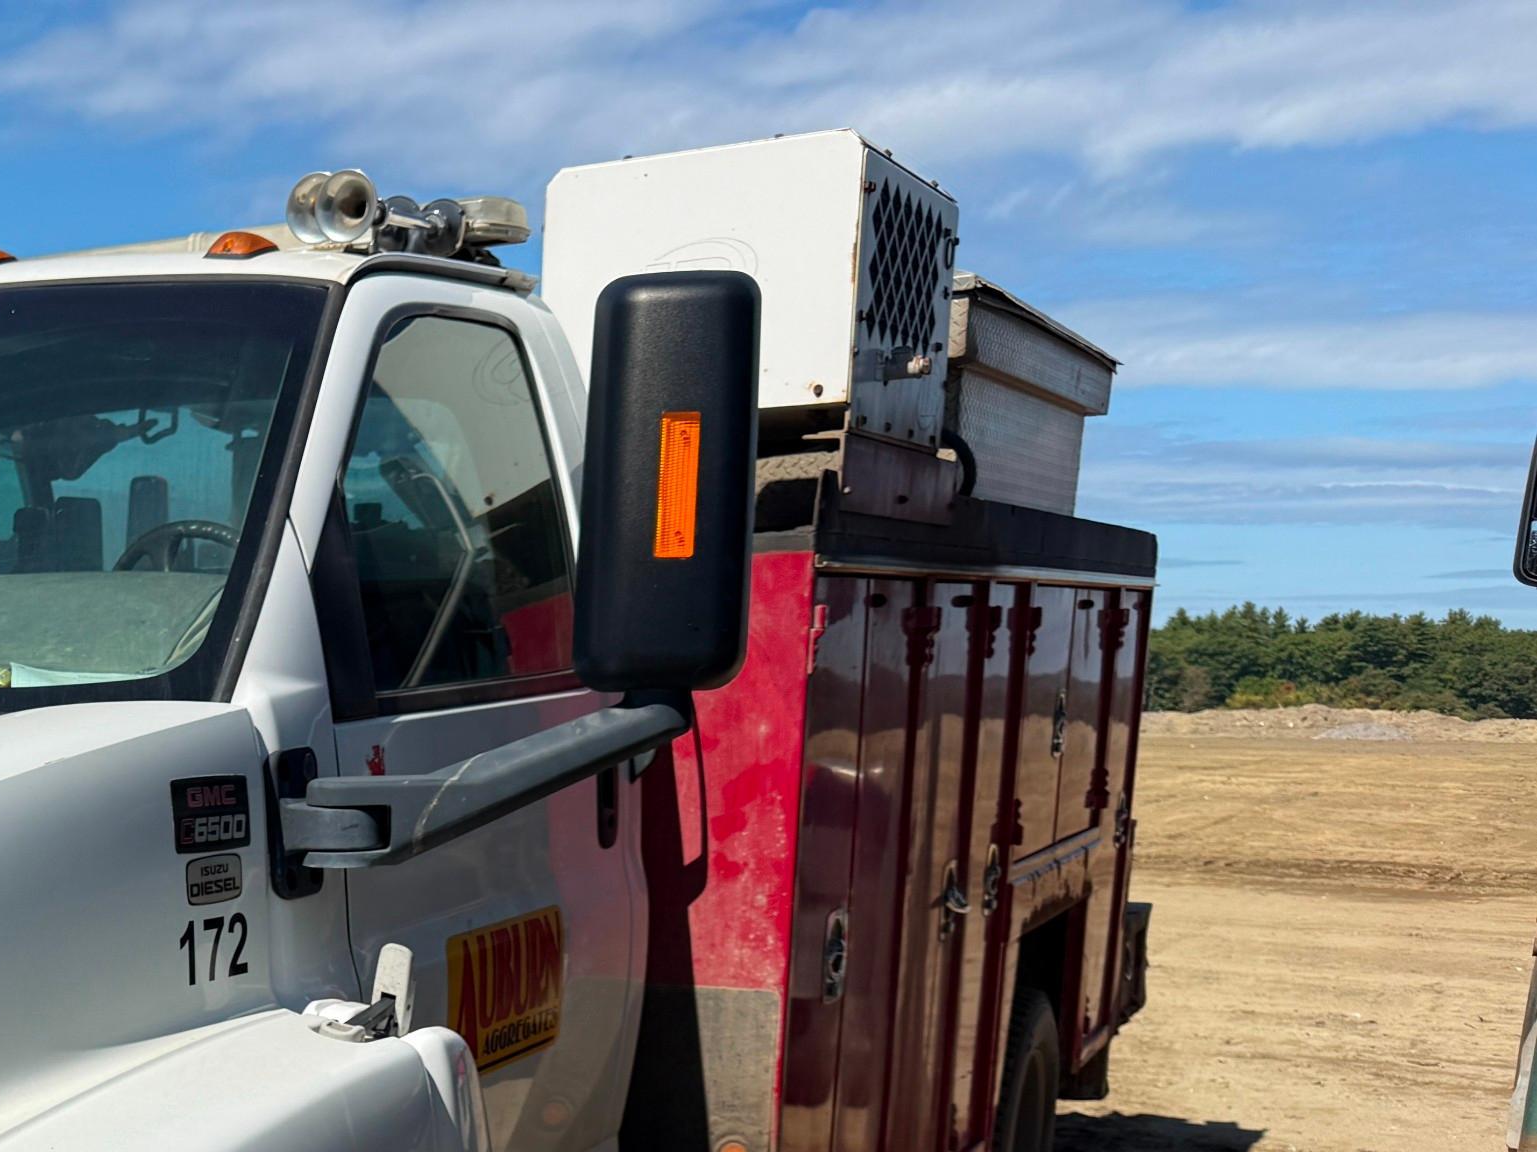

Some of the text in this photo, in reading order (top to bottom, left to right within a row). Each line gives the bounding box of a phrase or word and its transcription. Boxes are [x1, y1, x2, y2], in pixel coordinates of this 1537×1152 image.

[187, 784, 236, 808] GMC
[180, 813, 246, 845] C6500
[200, 863, 228, 877] ISUZU
[190, 877, 240, 898] DIESEL
[179, 912, 248, 986] 172
[457, 911, 561, 1060] AUBURN
[482, 1008, 560, 1056] AGGREGATES
